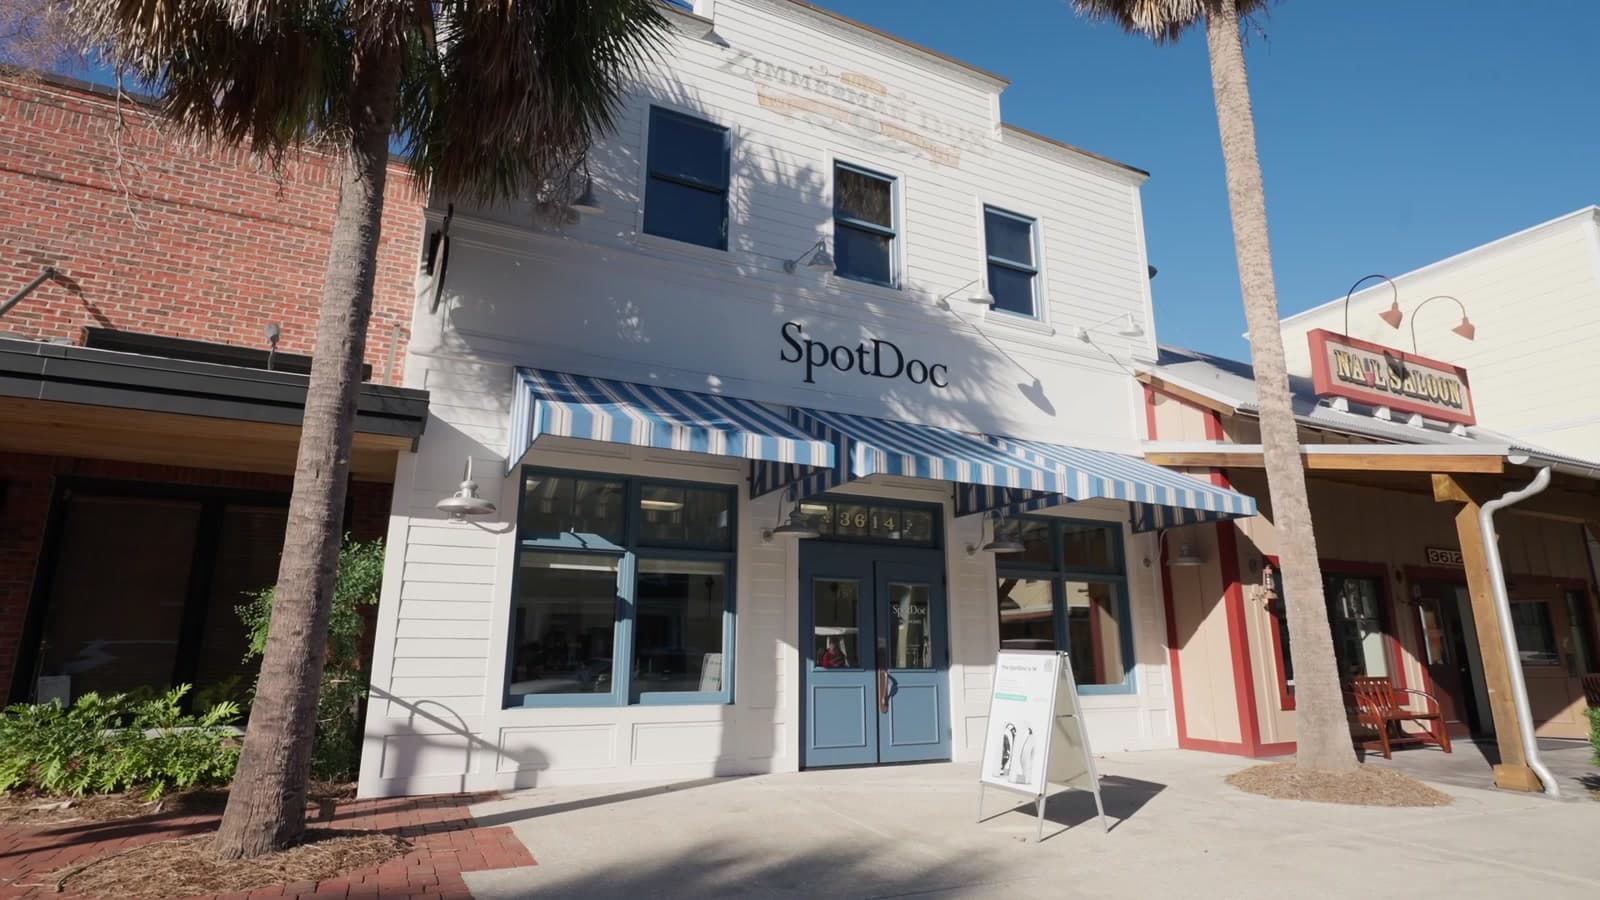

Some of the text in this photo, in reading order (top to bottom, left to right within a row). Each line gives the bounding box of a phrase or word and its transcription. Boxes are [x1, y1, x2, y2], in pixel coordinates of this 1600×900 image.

[780, 321, 949, 388] SpotDoc
[839, 511, 897, 531] 3614
[1430, 550, 1464, 564] 3612
[892, 604, 926, 617] SpDoc
